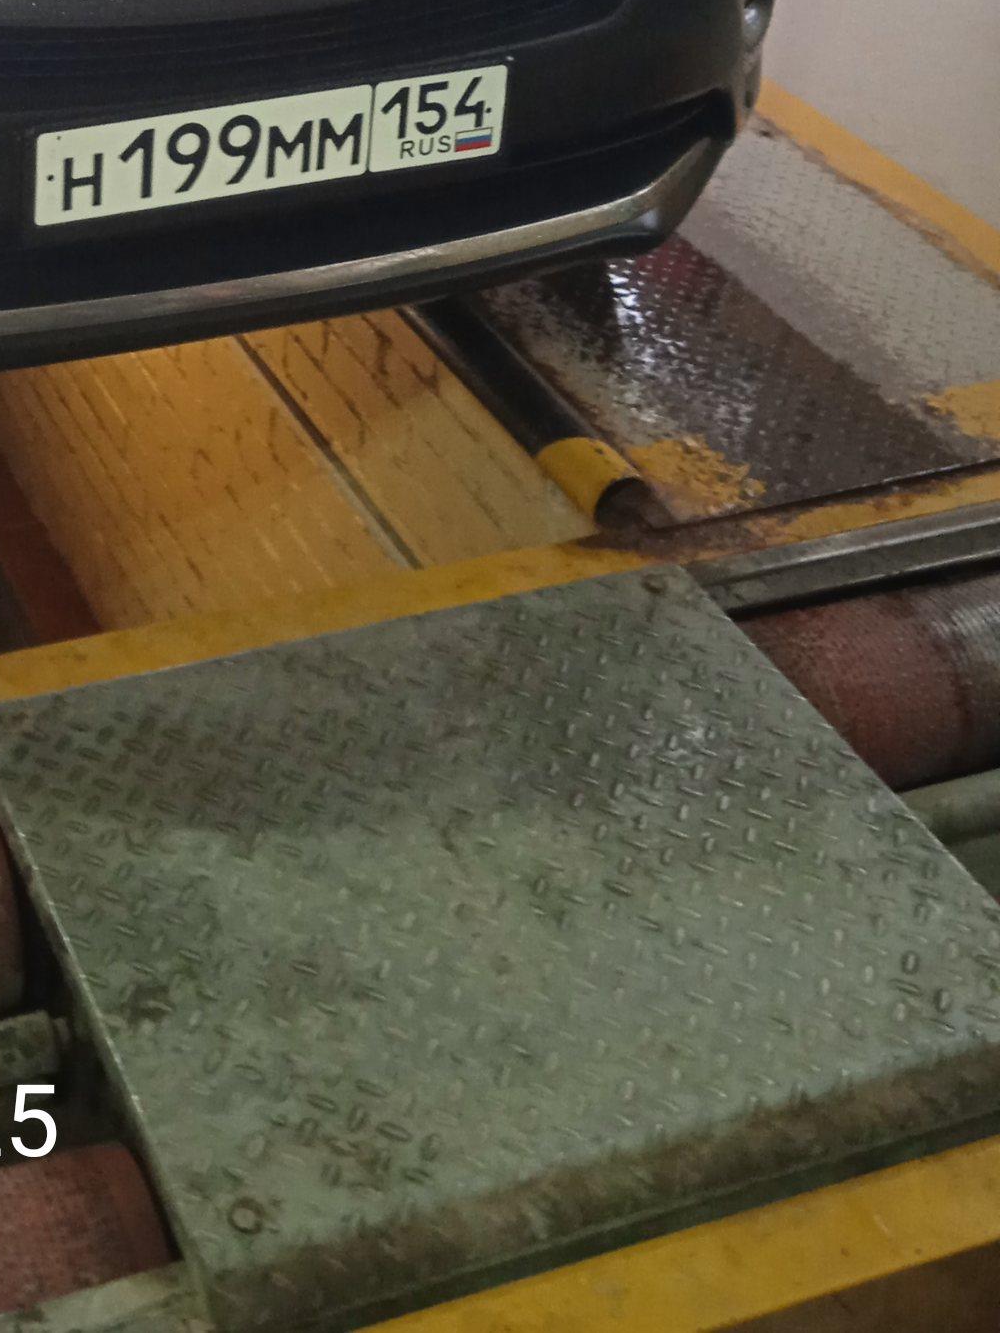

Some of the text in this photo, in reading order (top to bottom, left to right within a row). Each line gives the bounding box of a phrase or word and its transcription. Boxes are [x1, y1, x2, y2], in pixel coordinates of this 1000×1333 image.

[62, 76, 486, 212] Н199ММ 154
[400, 135, 452, 159] RUS
